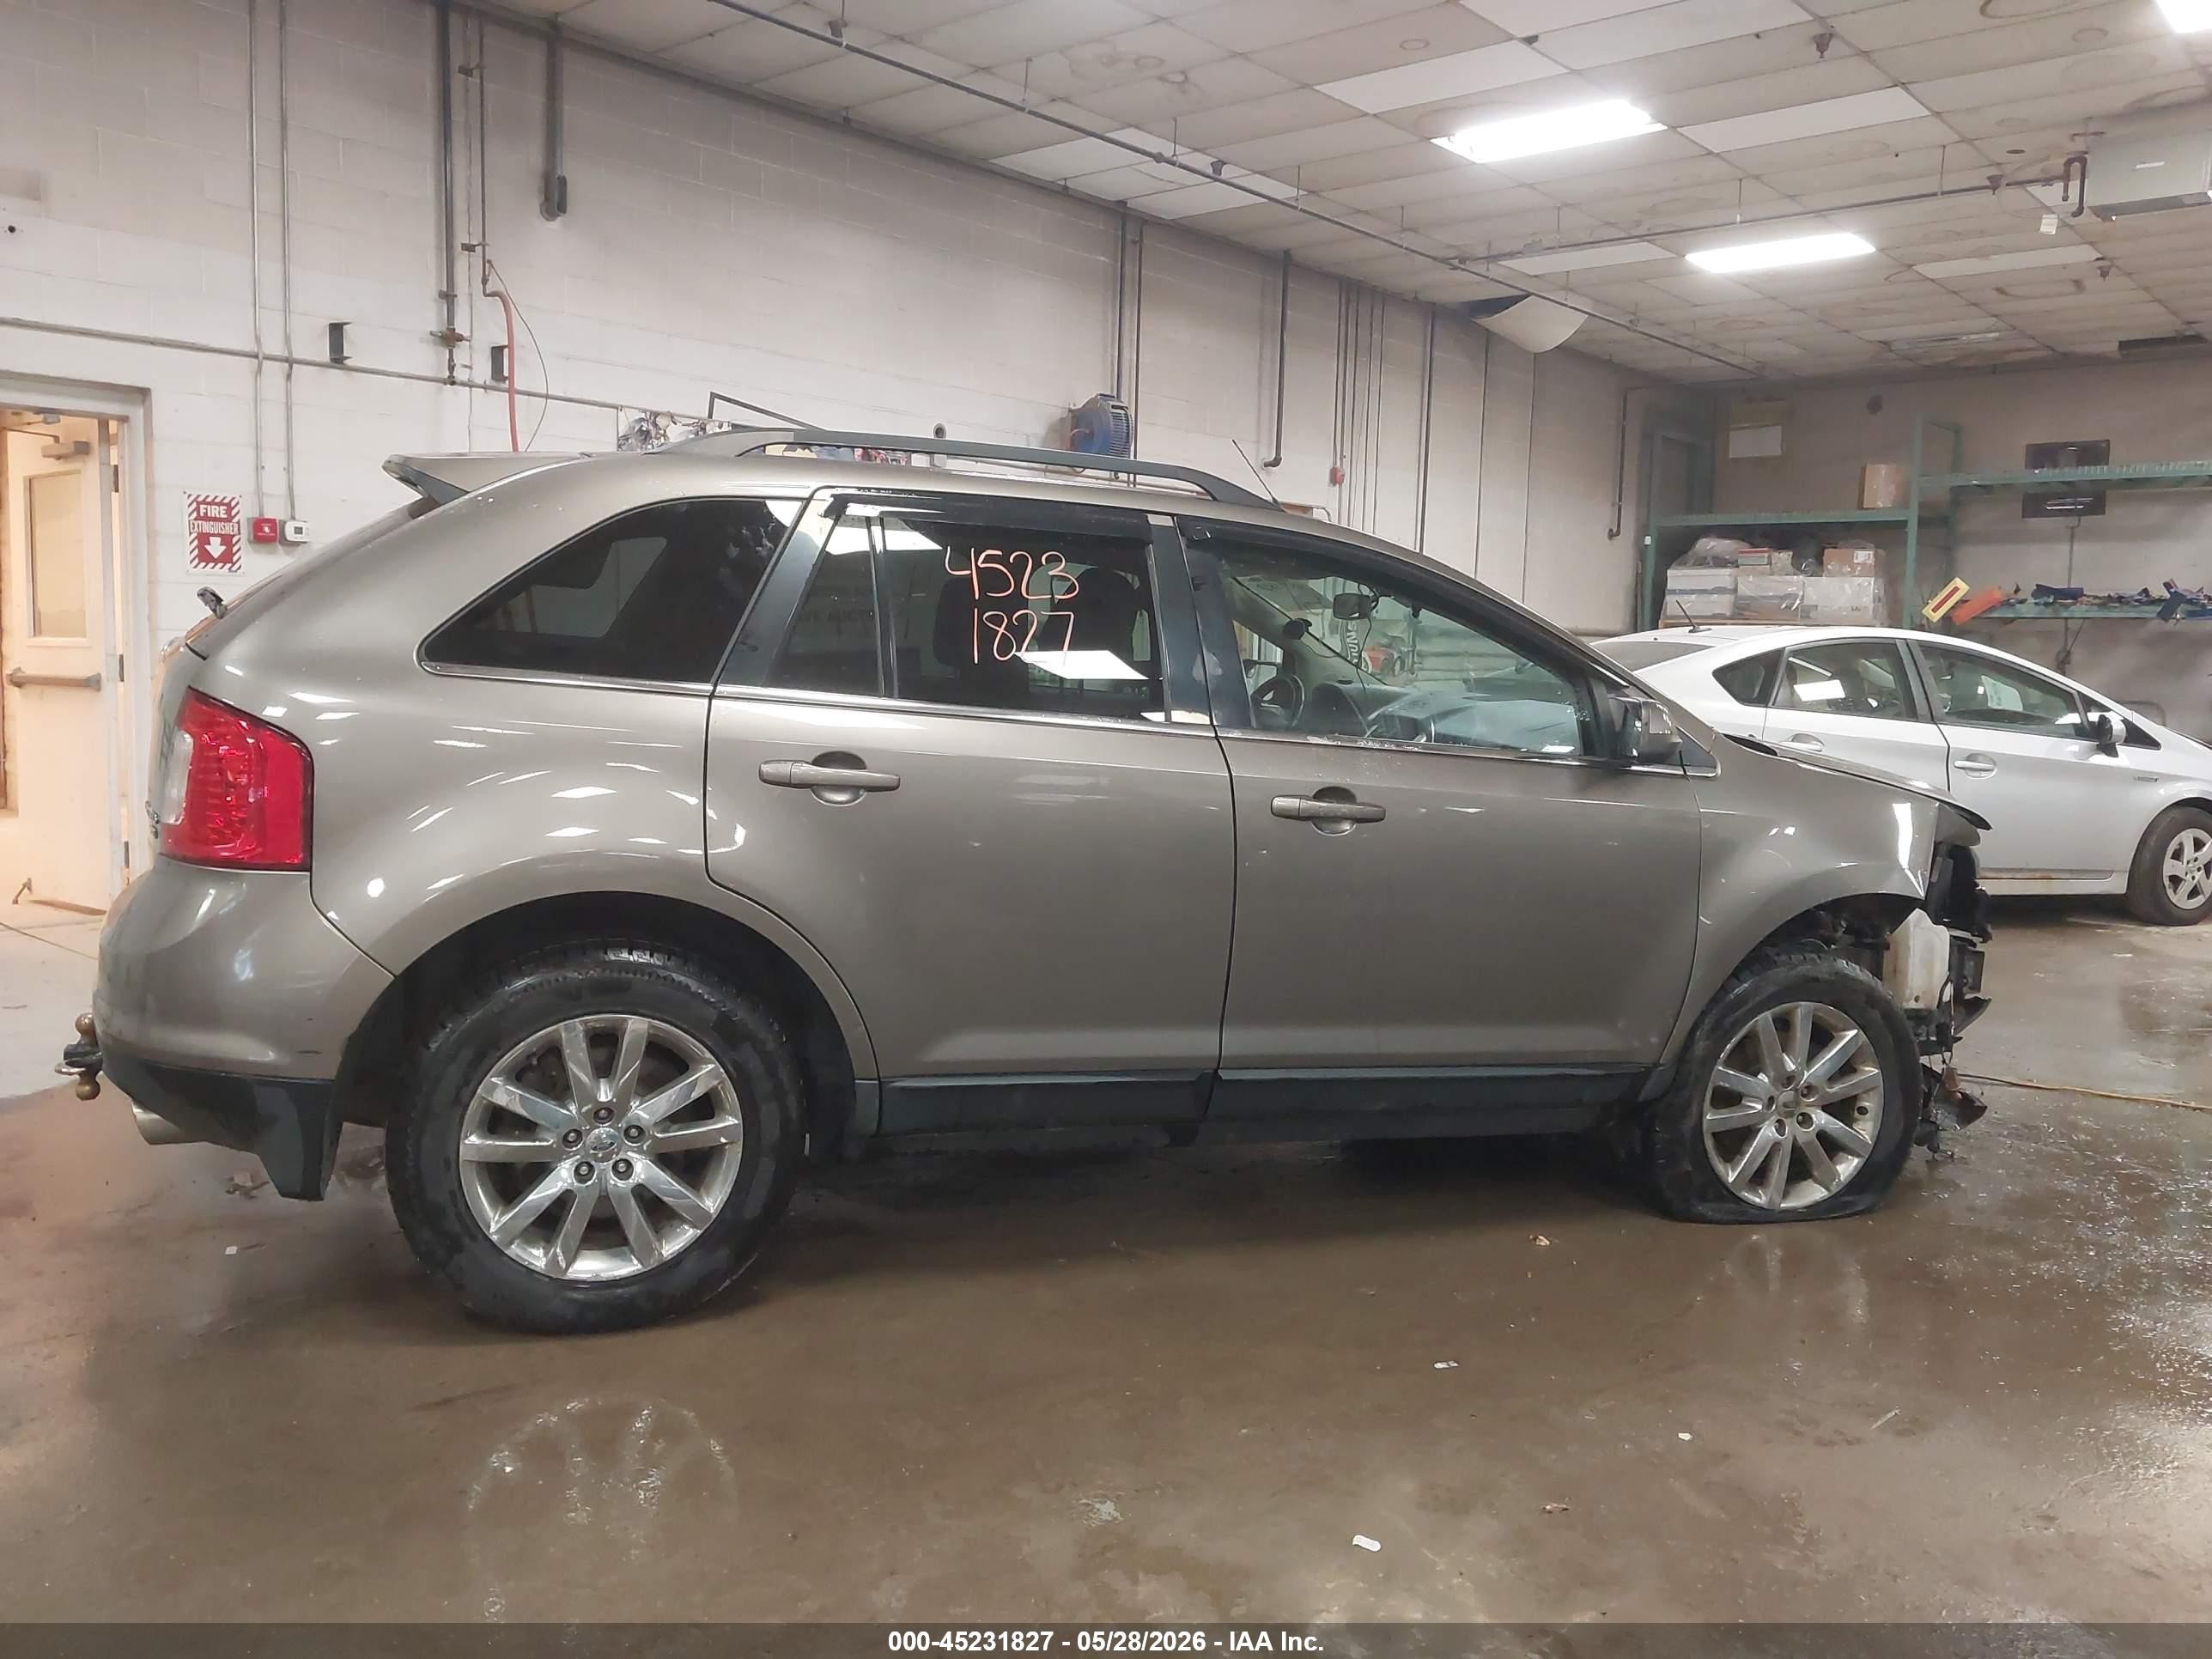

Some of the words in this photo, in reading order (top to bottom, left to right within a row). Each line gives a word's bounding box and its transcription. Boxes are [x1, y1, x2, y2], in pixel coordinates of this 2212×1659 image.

[189, 520, 240, 536] EXTINGUISHER
[199, 504, 228, 519] FIRE
[945, 545, 1080, 600] 4523
[974, 607, 1075, 666] 1827
